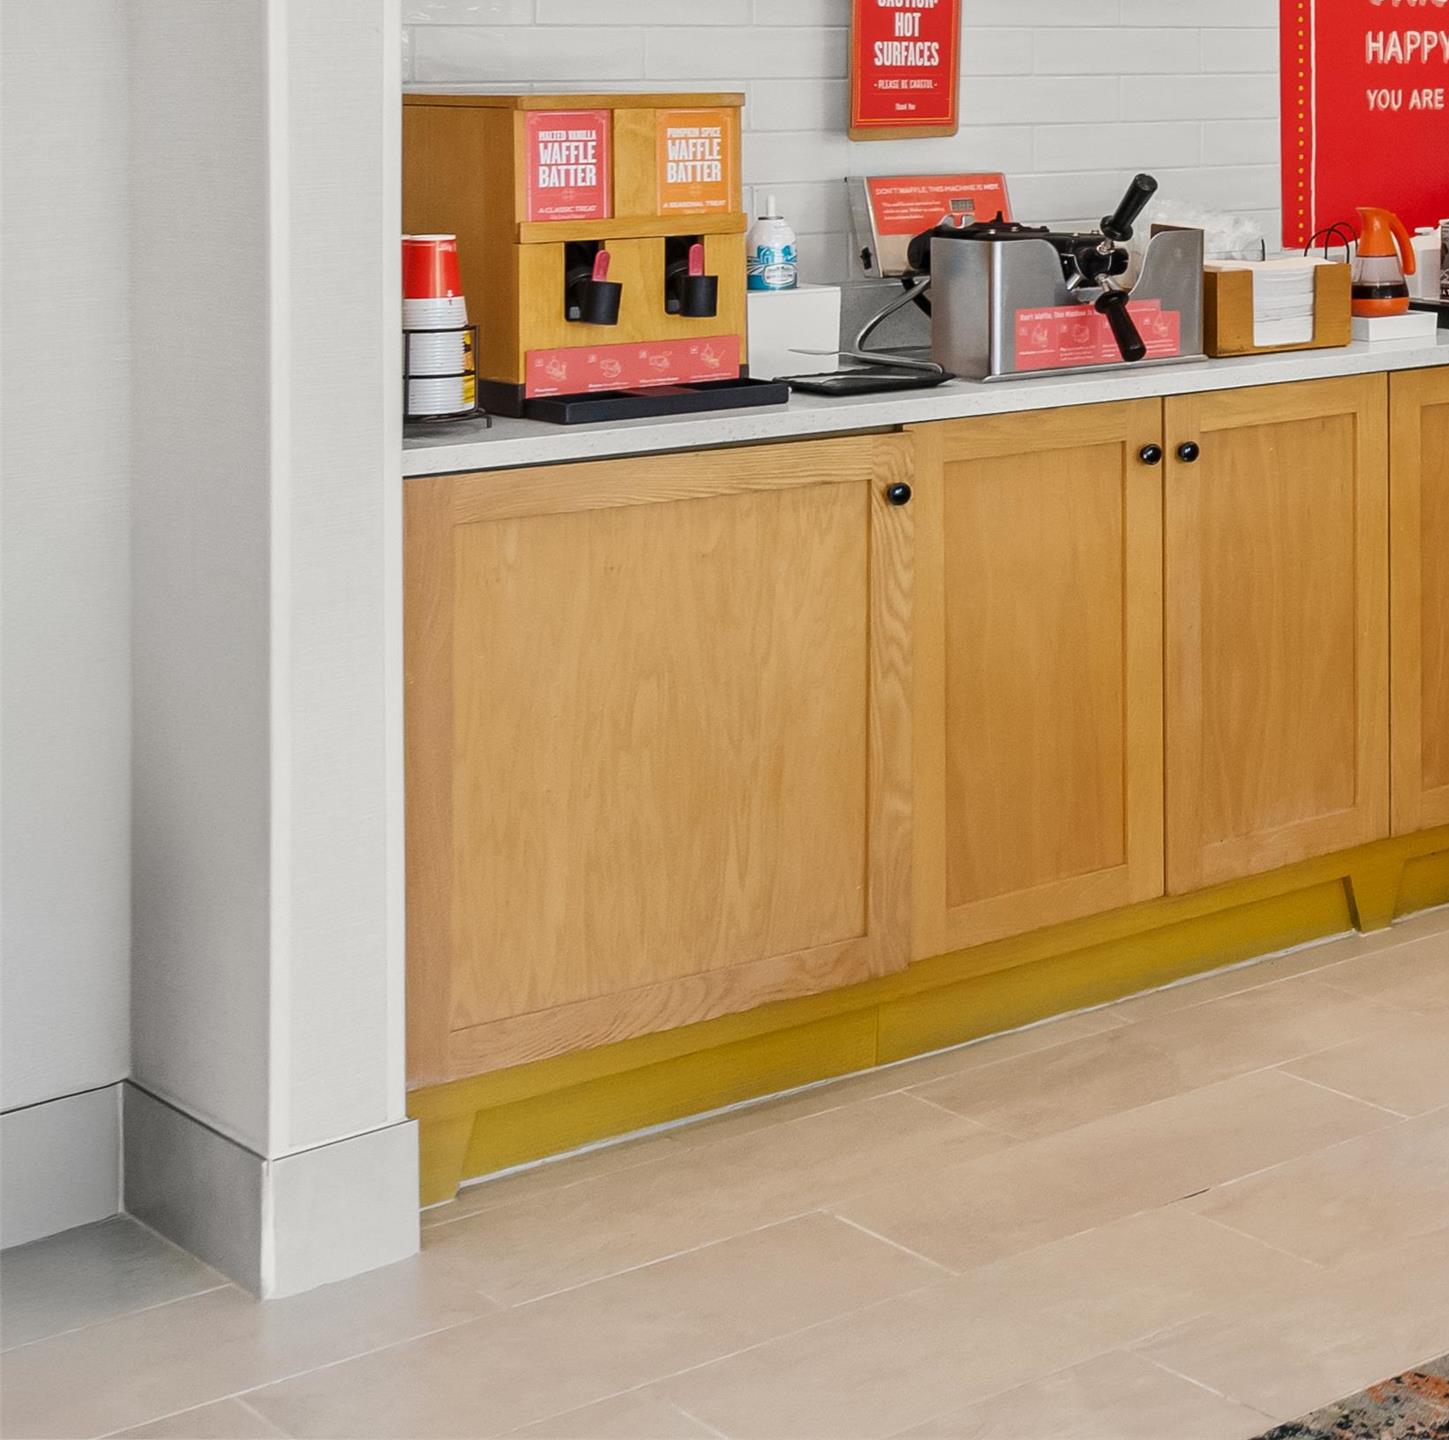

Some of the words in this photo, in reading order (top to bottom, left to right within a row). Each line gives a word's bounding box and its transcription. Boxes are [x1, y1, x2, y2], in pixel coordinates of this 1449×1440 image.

[894, 12, 921, 37] HOT
[874, 41, 940, 67] SURFACES
[1366, 88, 1402, 111] YOU
[1409, 88, 1445, 110] ARE
[539, 141, 597, 164] WAFFLE
[667, 139, 721, 160] WAFFLE
[539, 164, 597, 188] BATTER
[667, 161, 721, 183] BATTER
